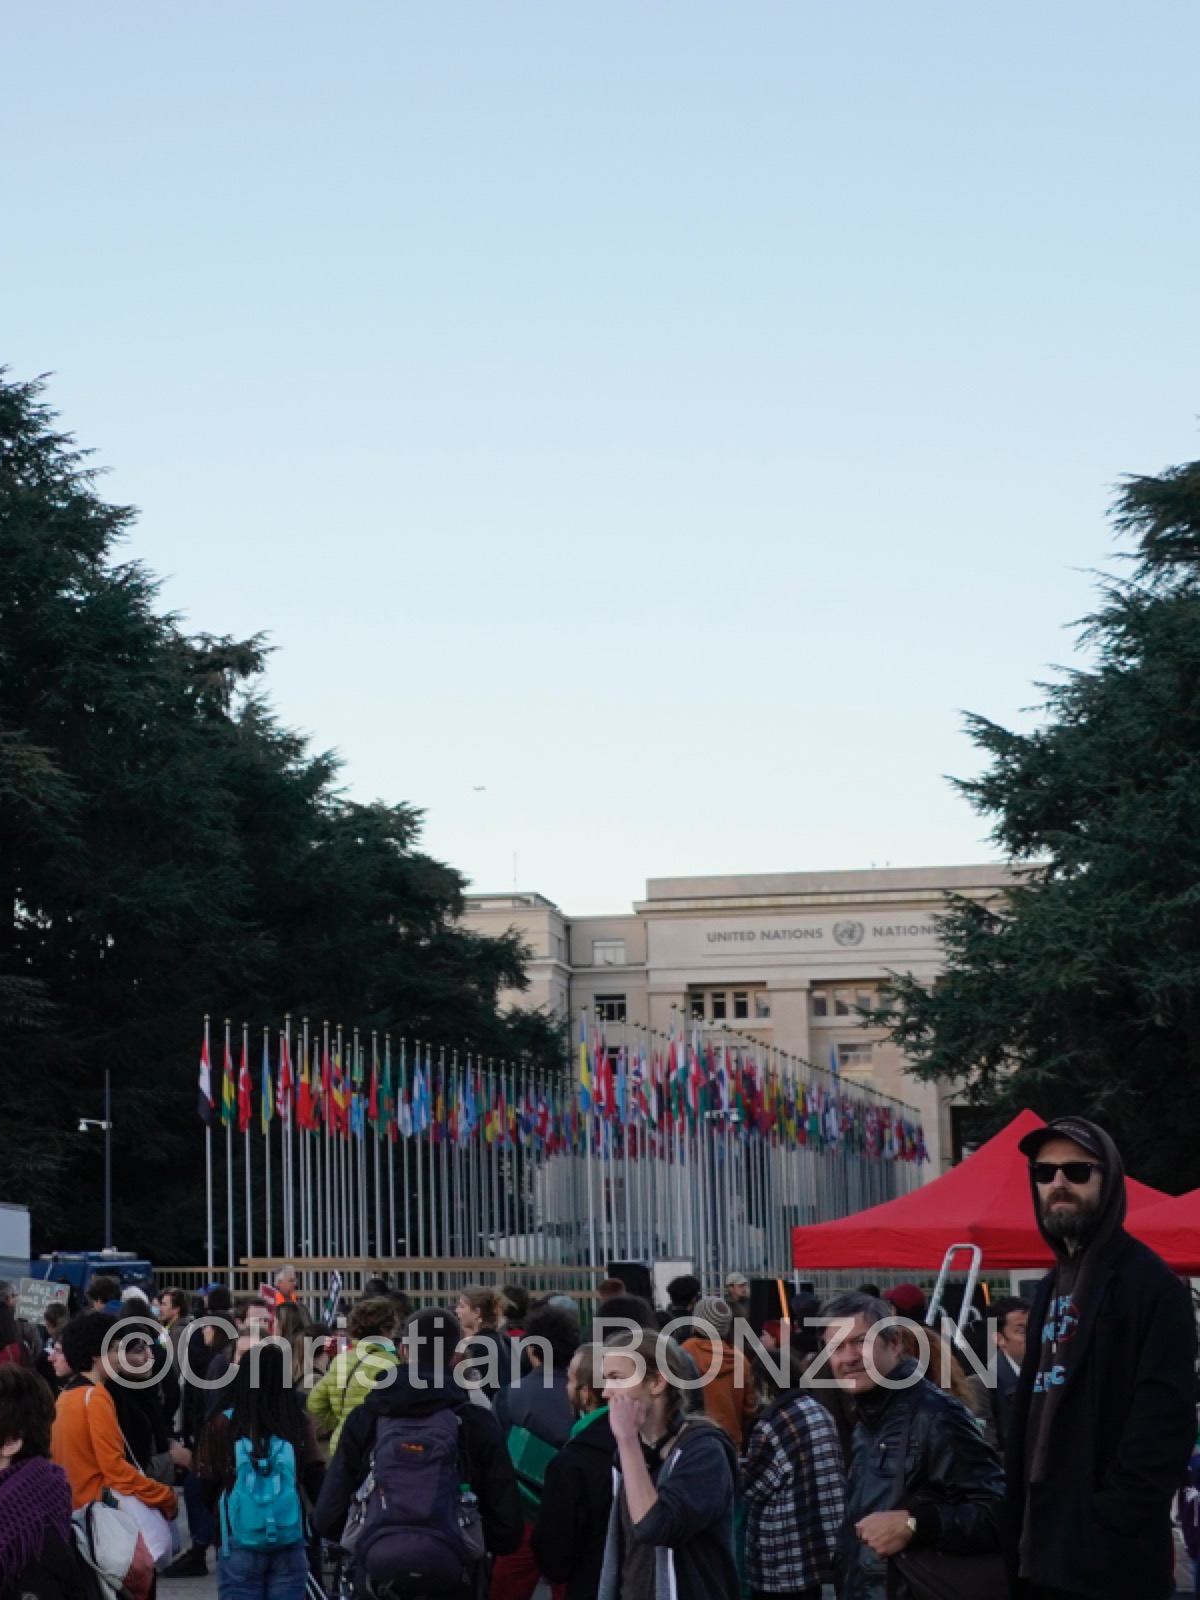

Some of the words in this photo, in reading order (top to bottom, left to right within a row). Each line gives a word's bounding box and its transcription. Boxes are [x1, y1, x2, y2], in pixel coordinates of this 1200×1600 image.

[706, 930, 756, 943] UNITED
[760, 927, 824, 941] NATIONS
[871, 923, 941, 937] NATION
